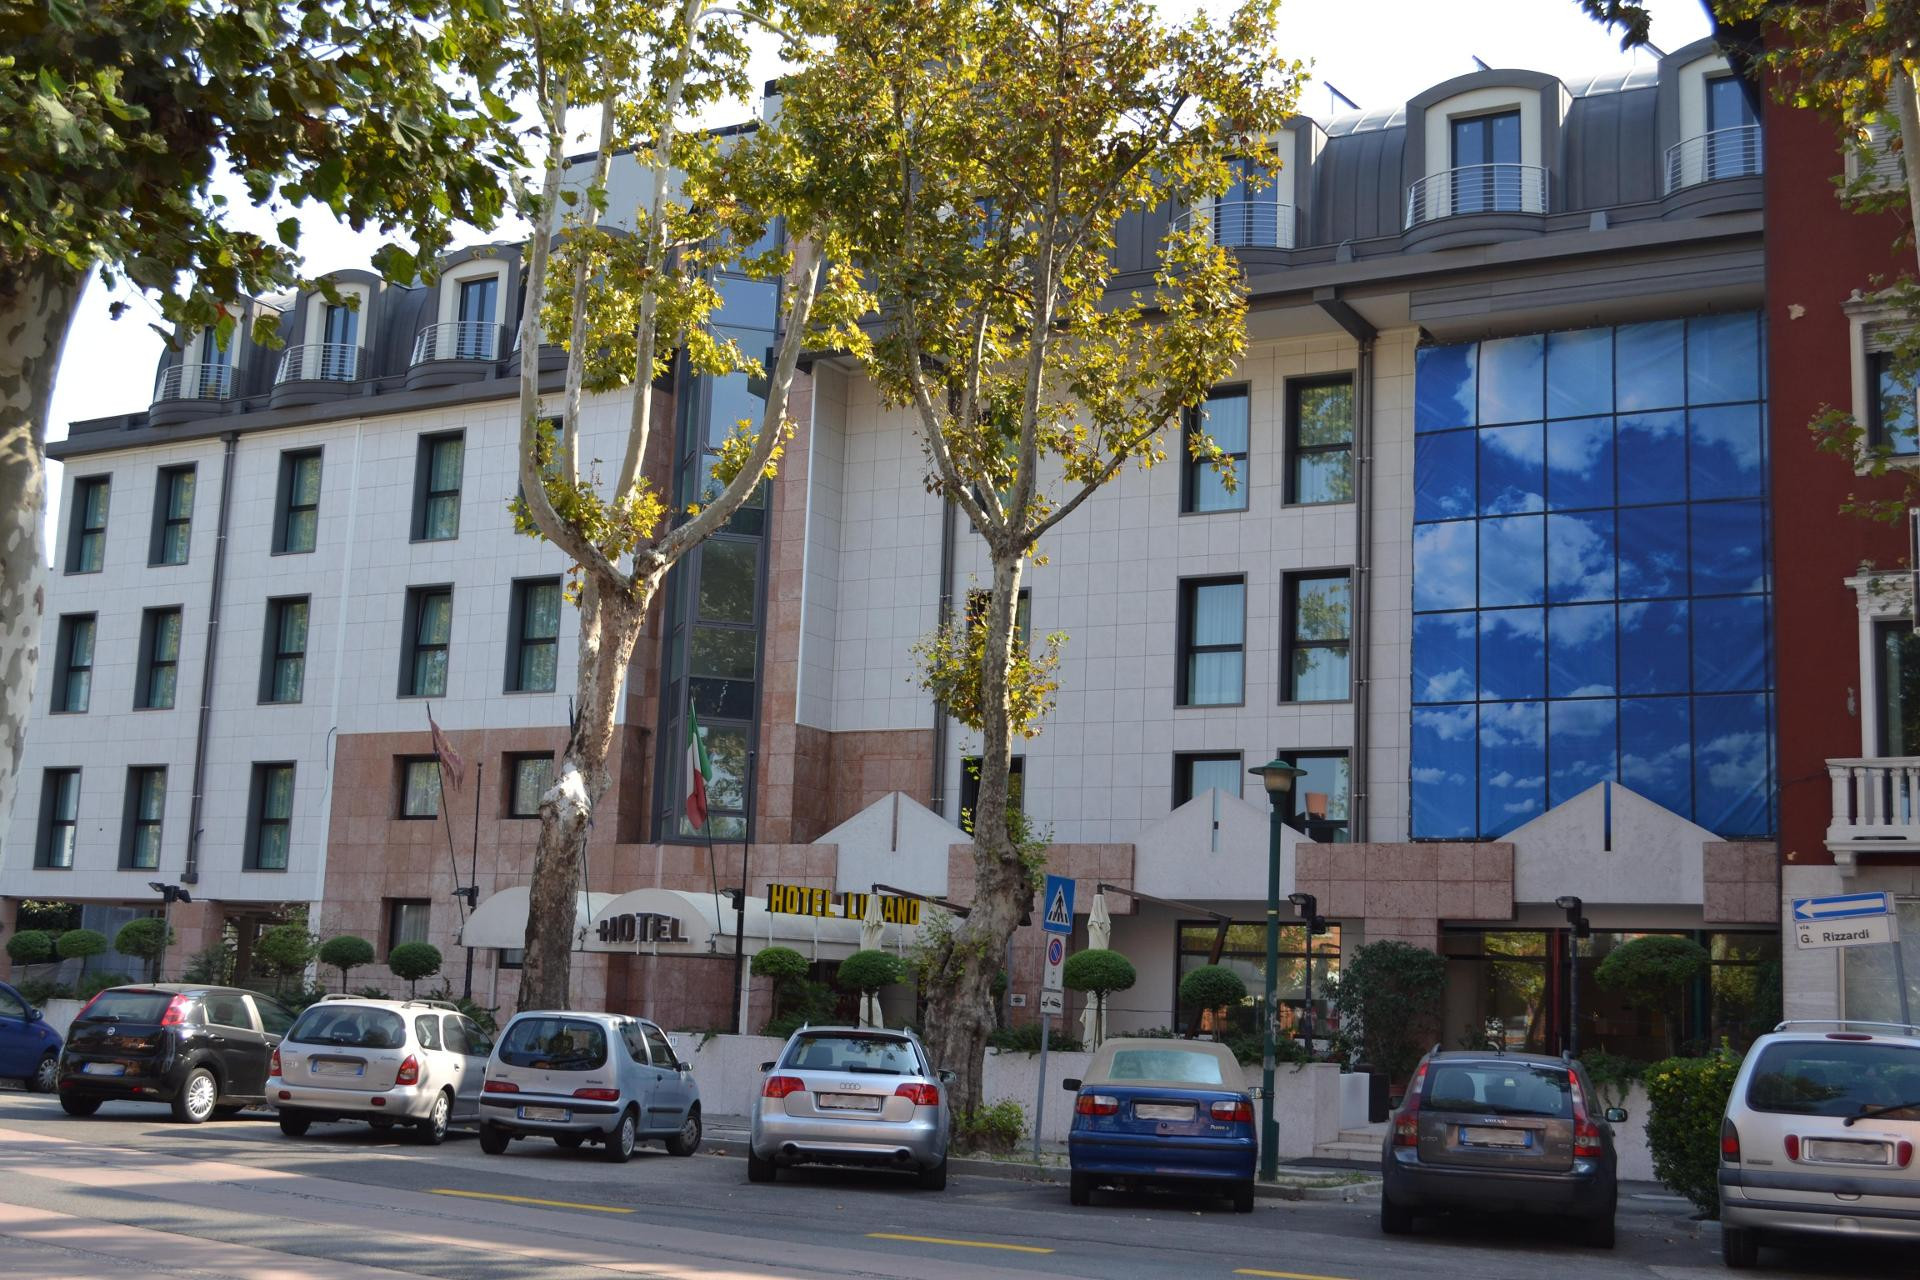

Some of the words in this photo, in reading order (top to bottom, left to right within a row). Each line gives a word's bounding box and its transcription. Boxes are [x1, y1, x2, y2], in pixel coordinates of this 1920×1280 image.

[768, 884, 836, 918] HOTEL
[845, 892, 920, 925] LUANO
[596, 912, 689, 943] HOTEL
[1800, 934, 1814, 944] G.
[1822, 929, 1870, 942] Rizzardi
